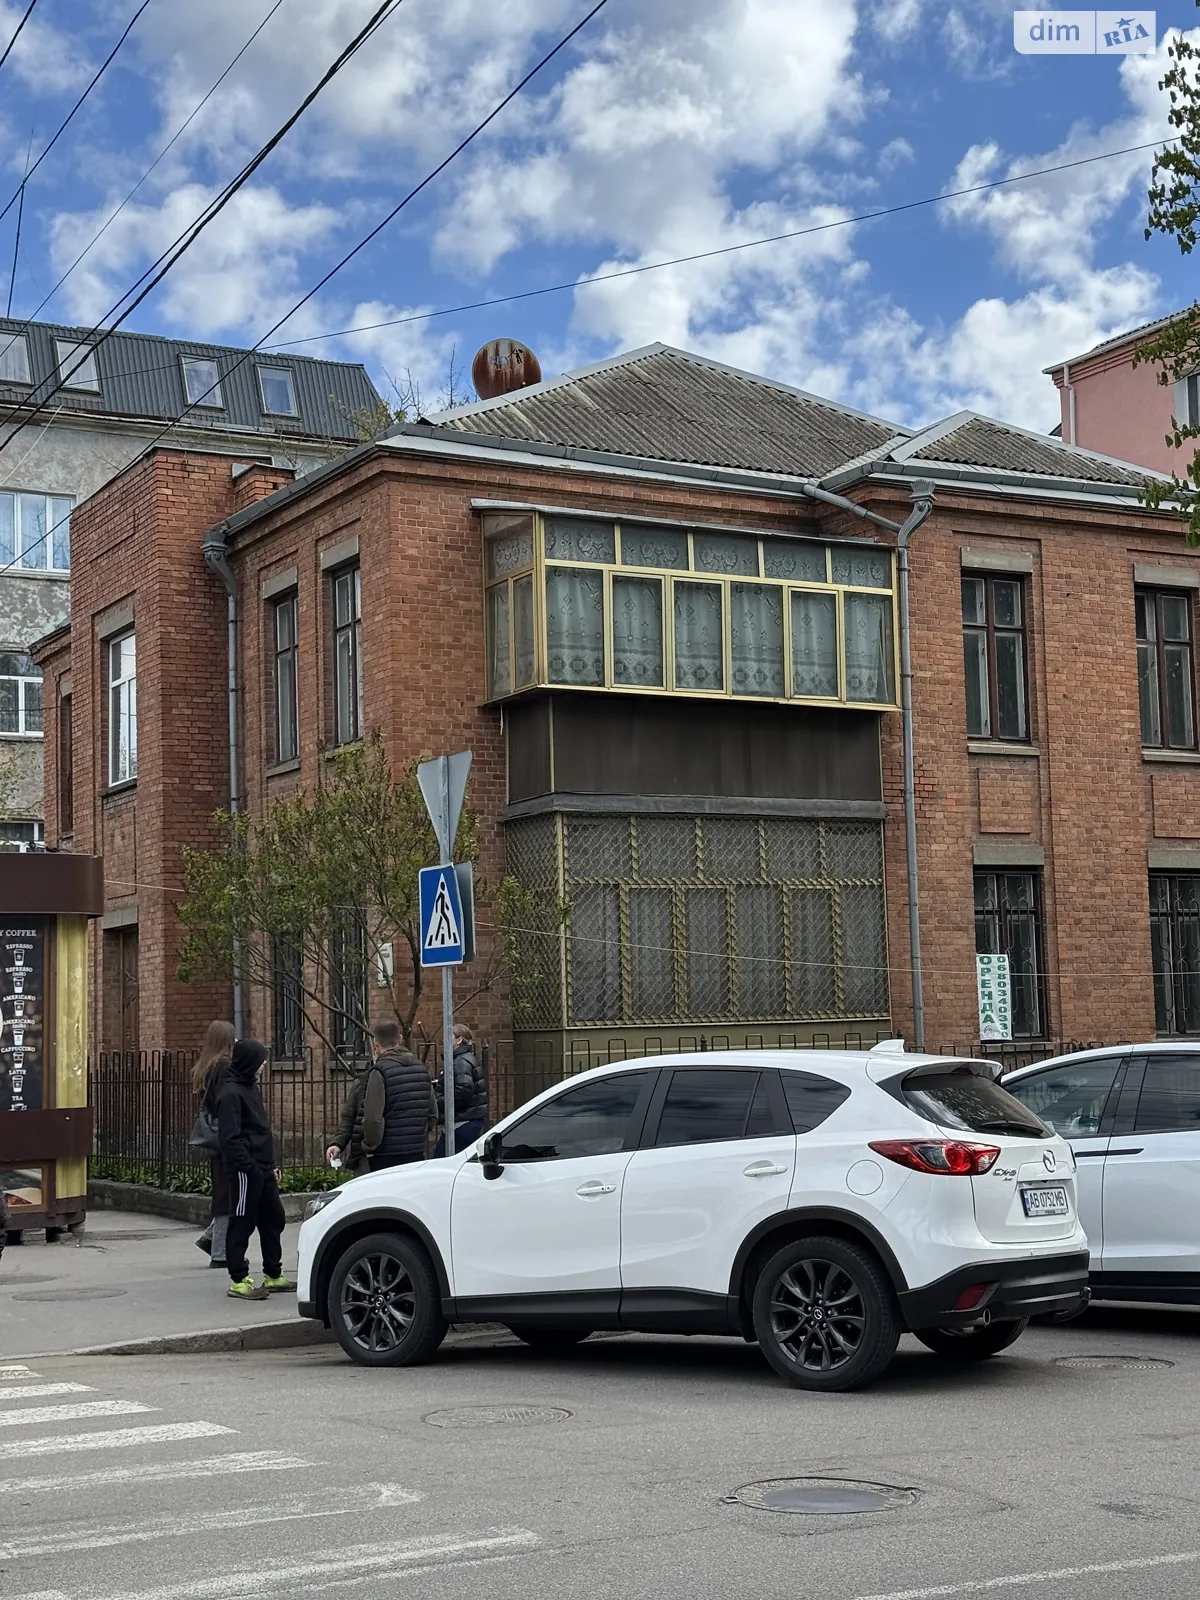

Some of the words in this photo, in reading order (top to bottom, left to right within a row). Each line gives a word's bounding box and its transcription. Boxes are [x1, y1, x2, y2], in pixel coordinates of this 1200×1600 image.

[5, 929, 37, 937] COFFEE
[979, 955, 995, 1024] ОРЕНДА
[3, 994, 37, 1002] AMERICANO
[996, 955, 1009, 1039] 0680340330
[0, 1045, 36, 1053] CAPPUCCINO
[1029, 1192, 1040, 1209] AB
[1039, 1191, 1056, 1208] 0752
